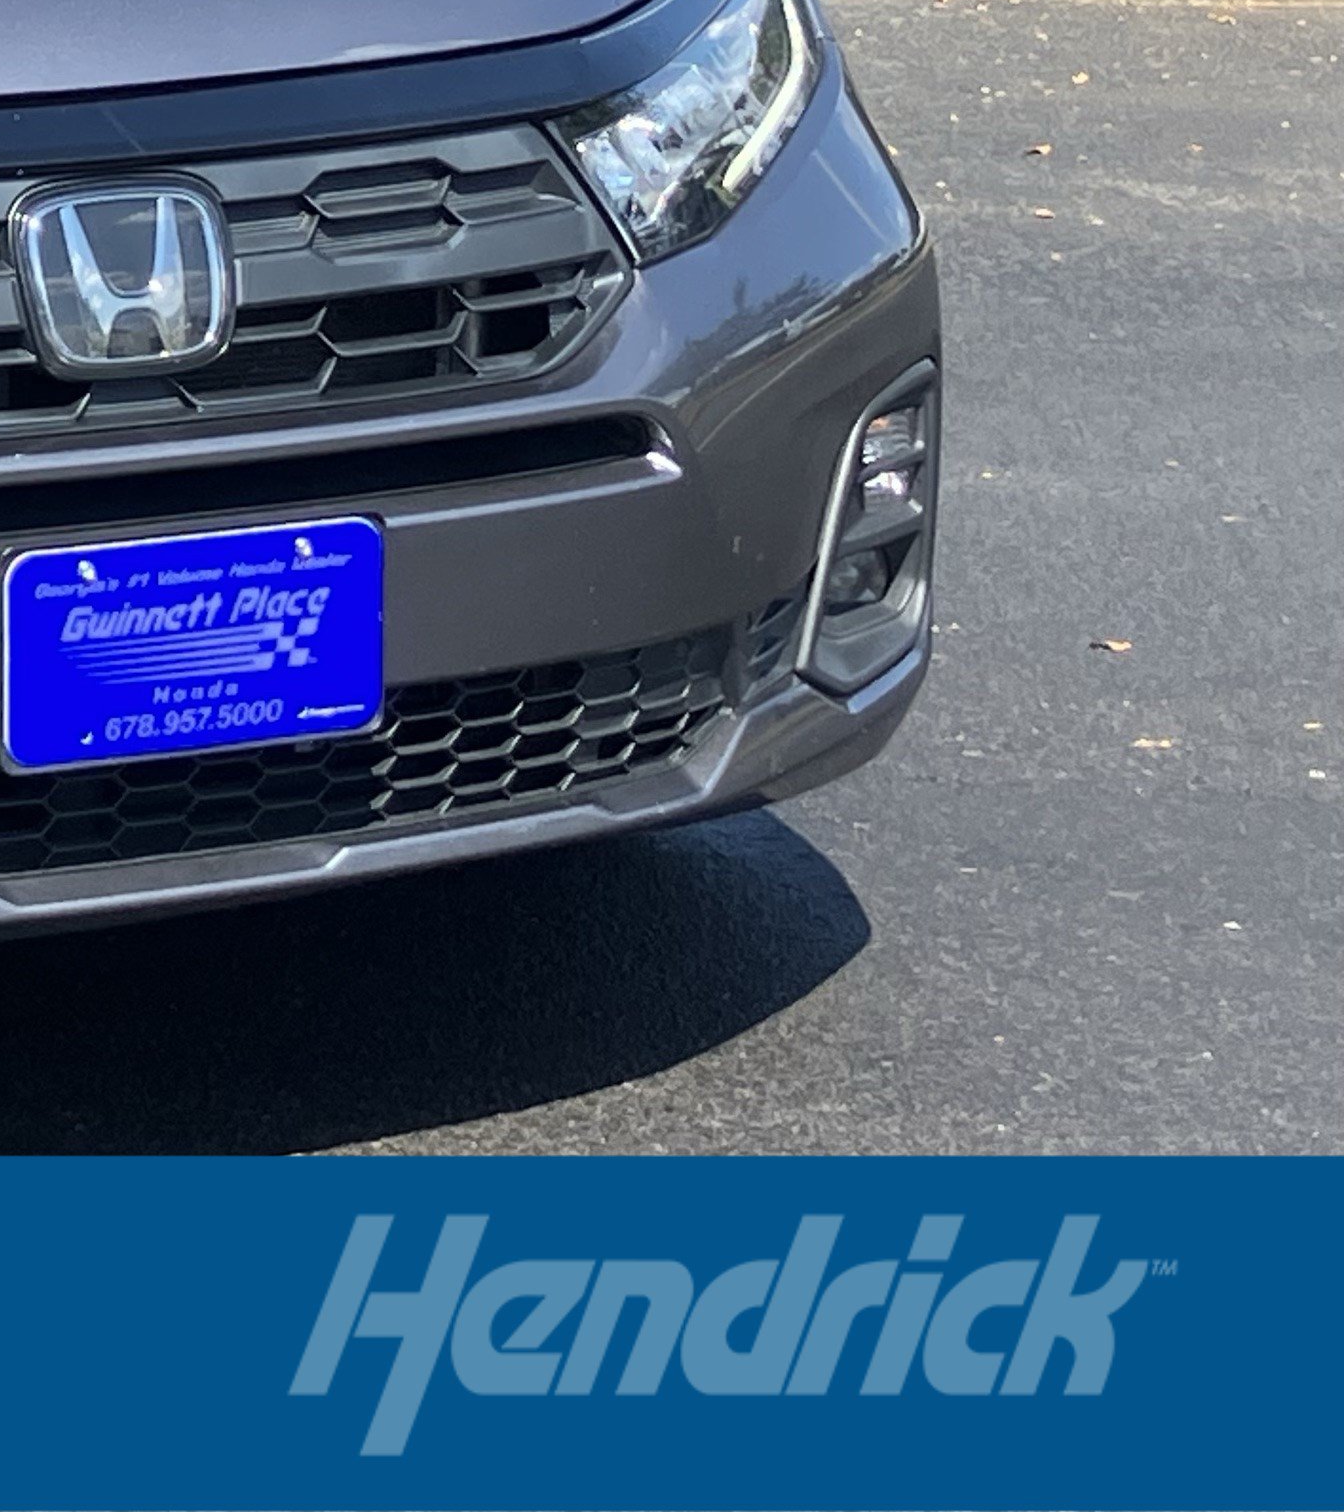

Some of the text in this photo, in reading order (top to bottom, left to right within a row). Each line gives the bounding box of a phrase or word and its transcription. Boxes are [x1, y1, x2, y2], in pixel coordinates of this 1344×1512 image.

[61, 585, 331, 642] Gwinnett Place
[153, 679, 239, 705] Honda
[105, 698, 283, 741] 678.957.5000
